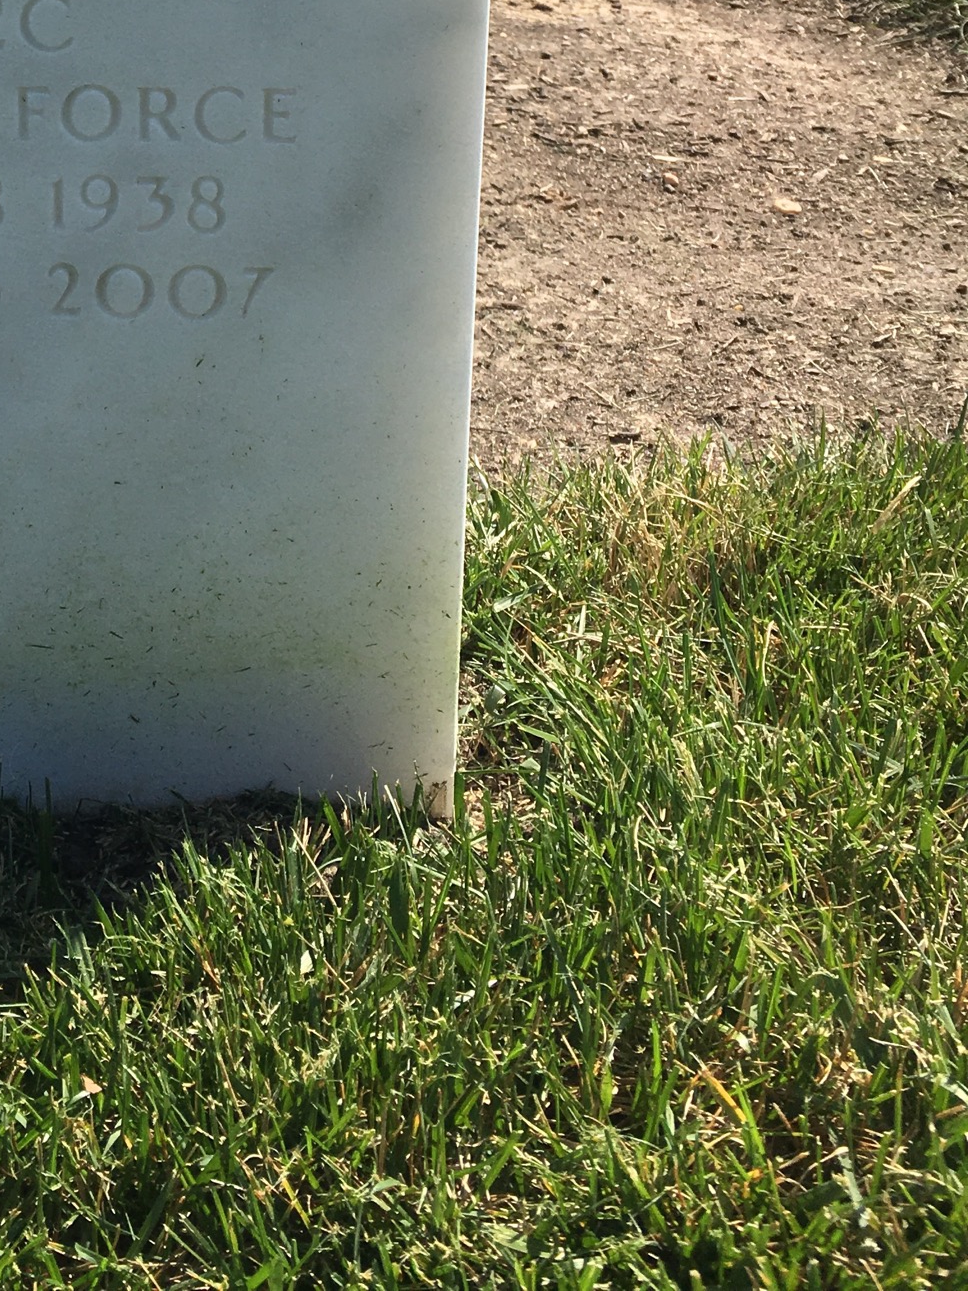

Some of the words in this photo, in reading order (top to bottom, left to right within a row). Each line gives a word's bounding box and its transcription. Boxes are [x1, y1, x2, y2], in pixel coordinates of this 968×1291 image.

[17, 83, 302, 145] FORCE
[51, 173, 227, 234] 1938
[47, 262, 276, 320] 2007
